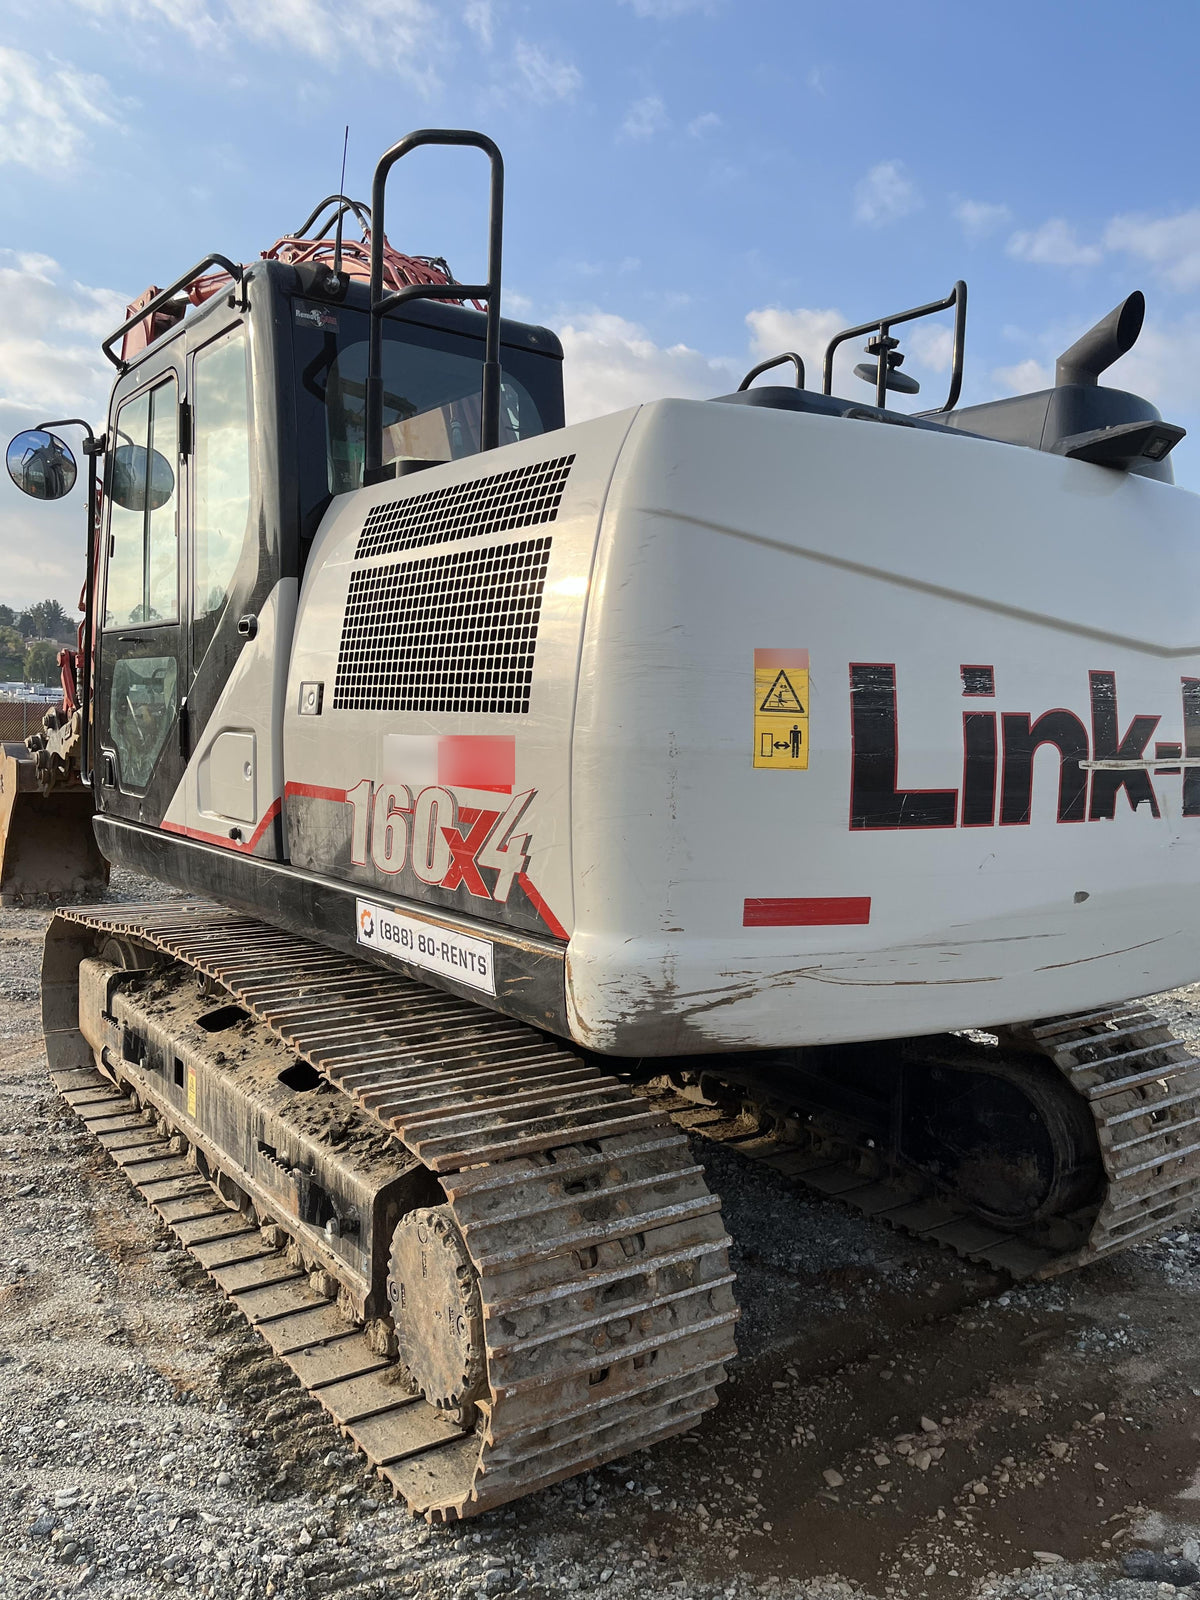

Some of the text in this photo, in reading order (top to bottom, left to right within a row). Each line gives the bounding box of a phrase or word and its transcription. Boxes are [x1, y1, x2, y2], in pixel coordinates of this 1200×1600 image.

[849, 662, 1200, 831] Link-
[379, 919, 487, 976] (888) 80-RENTS
